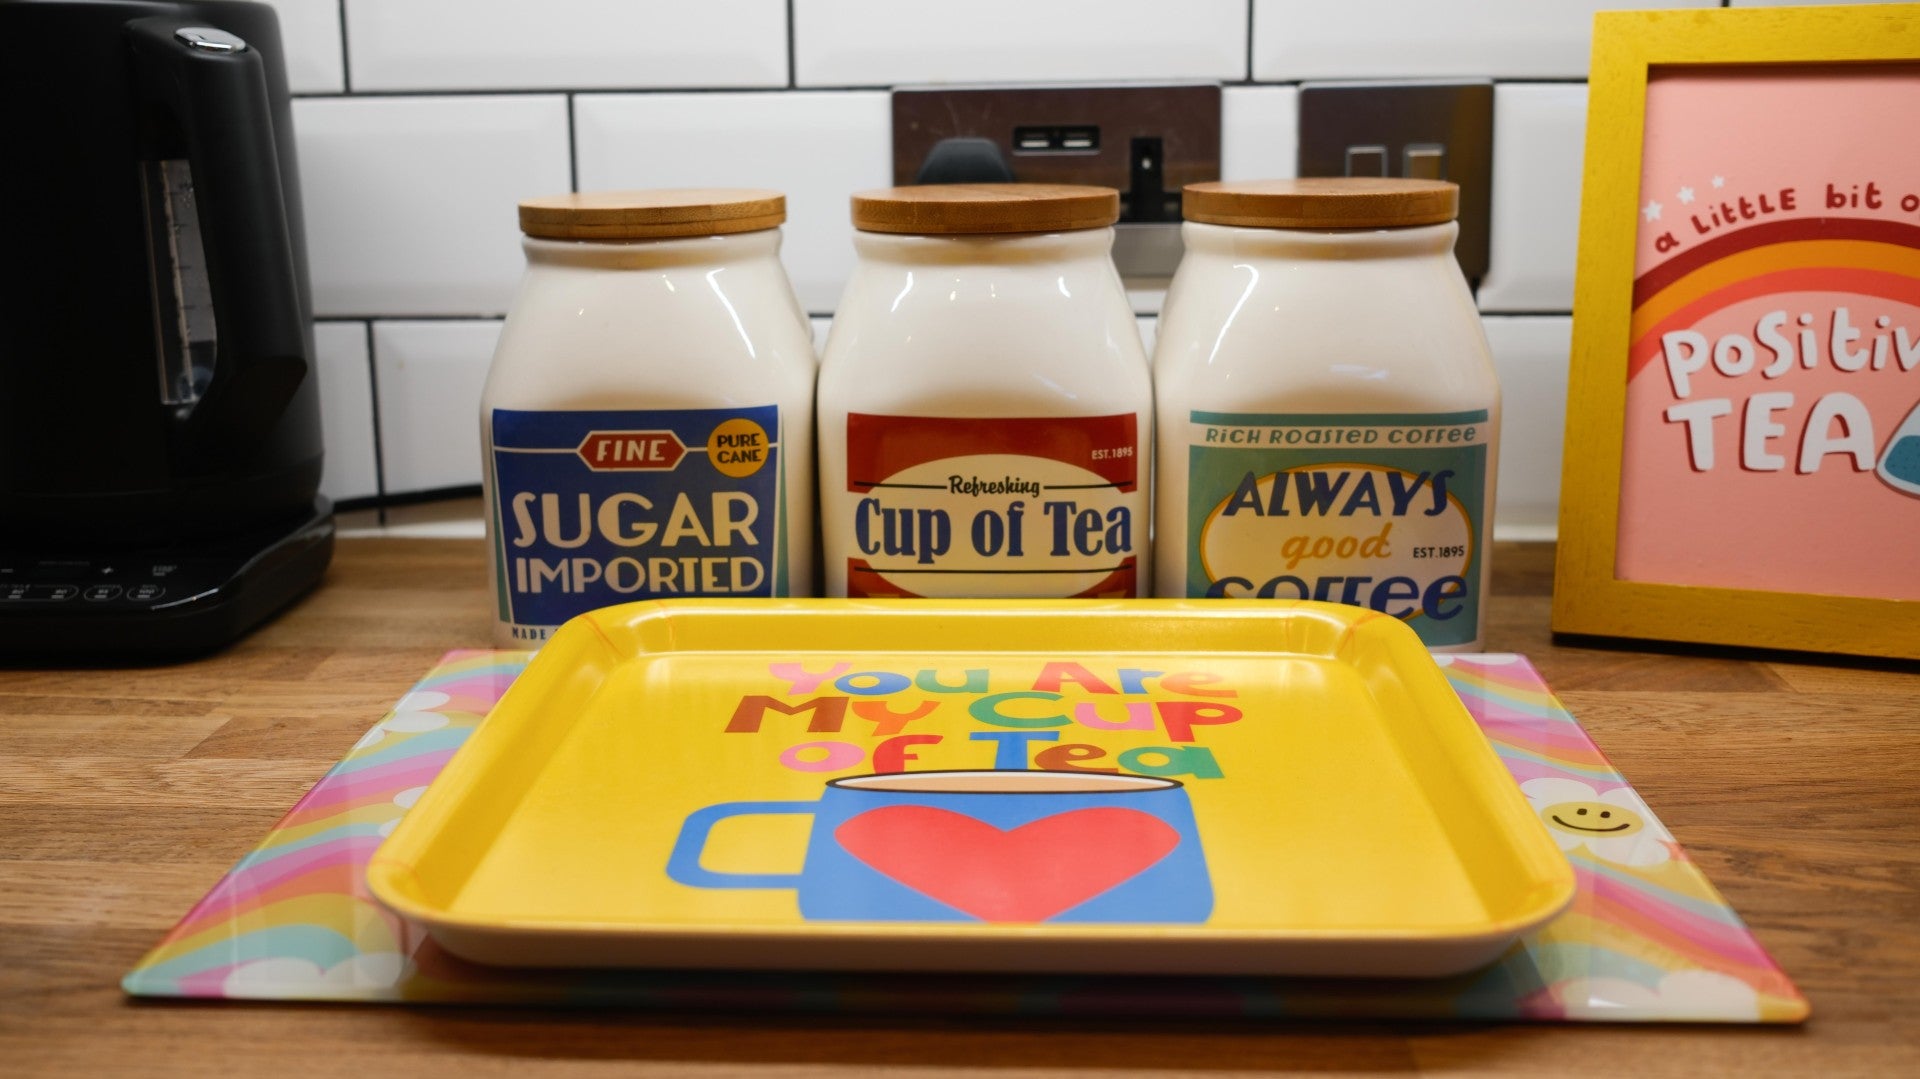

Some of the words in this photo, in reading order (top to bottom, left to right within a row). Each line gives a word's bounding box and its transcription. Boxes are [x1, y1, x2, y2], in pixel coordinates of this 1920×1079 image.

[1655, 232, 1680, 253] a
[1826, 182, 1882, 209] bit
[1900, 193, 1920, 214] o
[596, 439, 667, 462] FINE
[717, 433, 760, 448] PURE
[1663, 392, 1876, 475] TEA
[717, 450, 762, 464] CANE
[1091, 447, 1133, 459] EST.1895
[949, 475, 1040, 498] Refreshing
[1221, 470, 1455, 516] ALWAYS
[512, 492, 759, 549] SUGAR
[855, 498, 951, 564] Cup
[971, 501, 1025, 557] of
[1044, 501, 1132, 556] Tea
[1280, 522, 1393, 570] good
[1413, 546, 1465, 558] EST.1895
[516, 557, 765, 593] IMPORTED
[512, 627, 546, 640] MADE
[768, 662, 990, 696] You
[1031, 661, 1239, 698] Are
[724, 695, 941, 736] My
[968, 692, 1243, 742] Cup
[779, 734, 944, 774] of
[969, 731, 1225, 779] Tea
